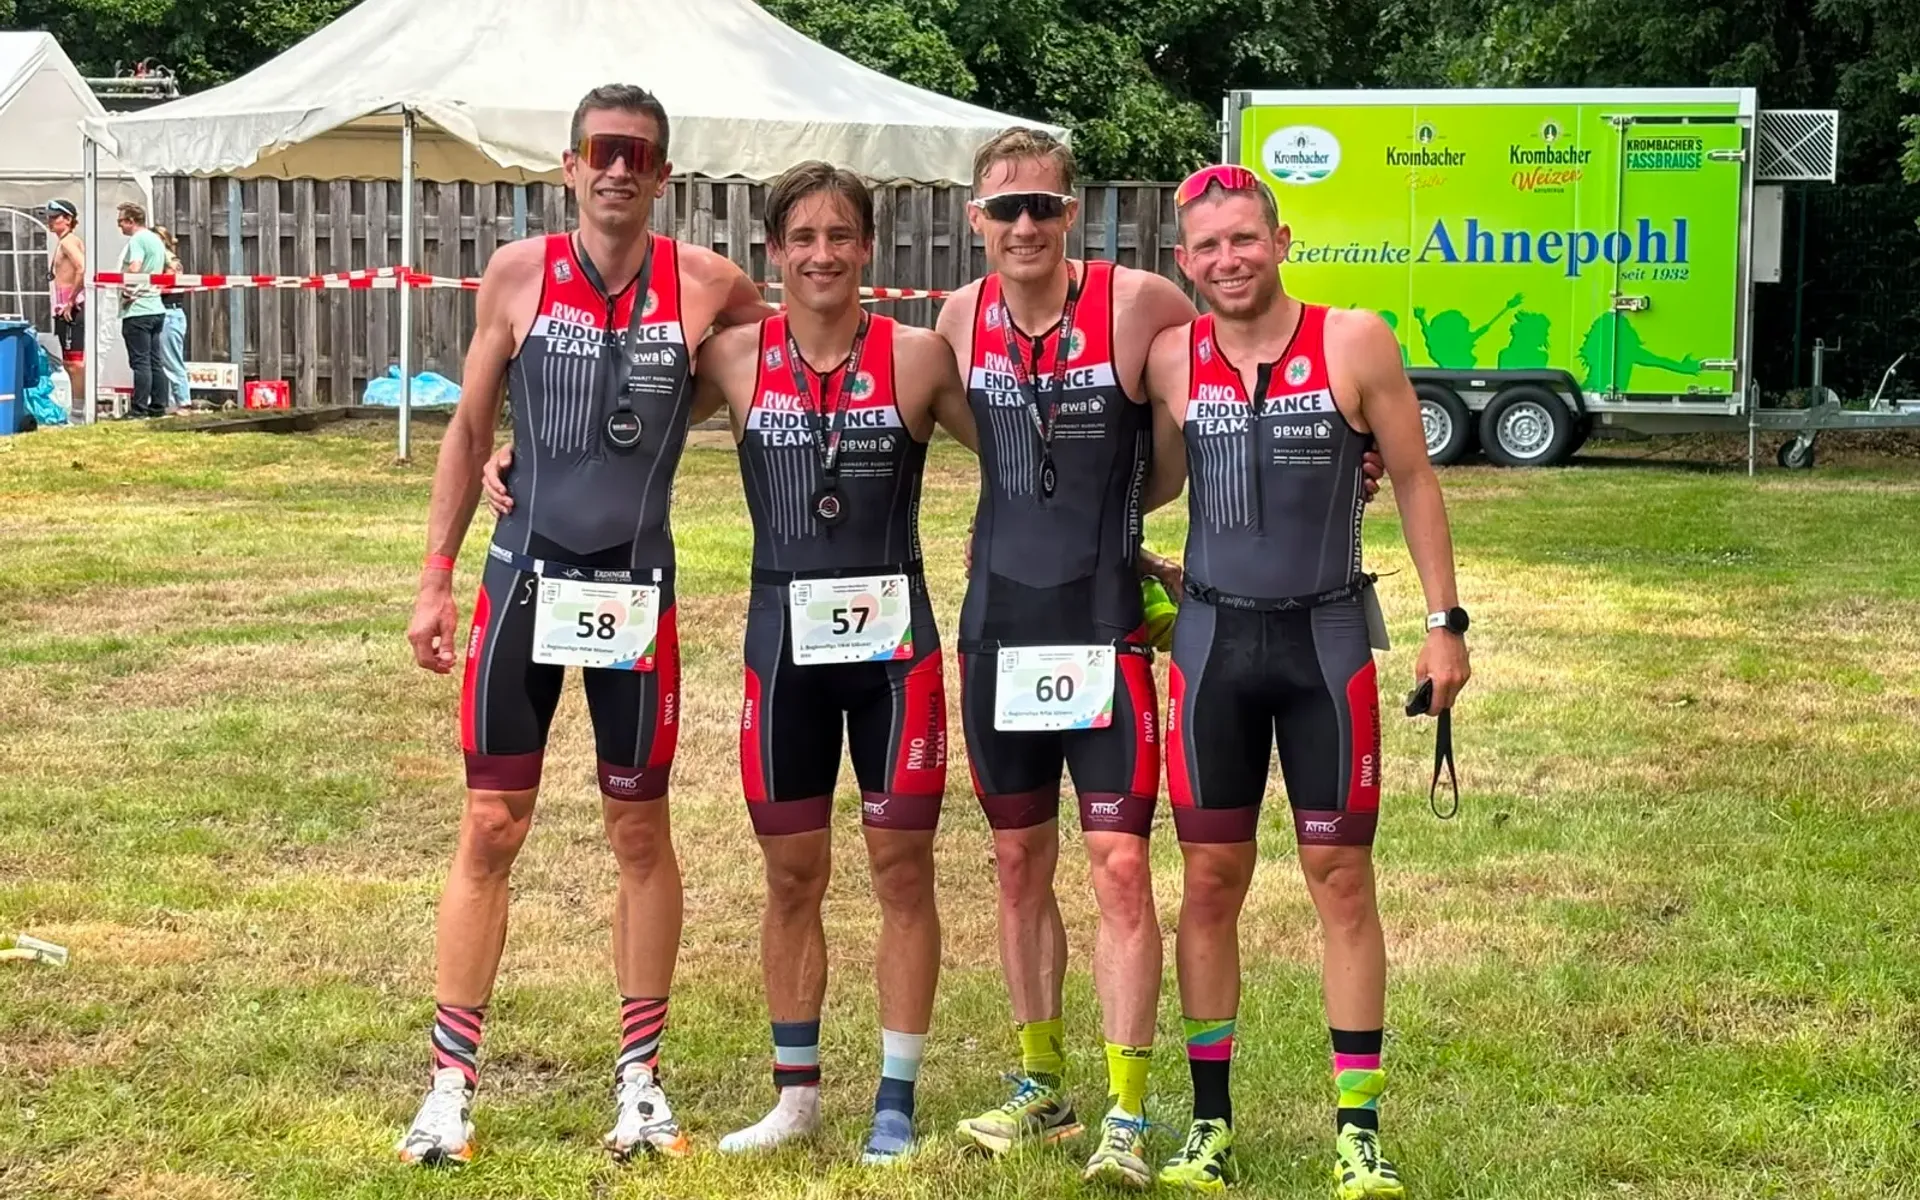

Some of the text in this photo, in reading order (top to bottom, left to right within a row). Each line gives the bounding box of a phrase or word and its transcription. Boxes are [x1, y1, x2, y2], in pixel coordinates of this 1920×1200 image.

[1386, 146, 1466, 166] Krombacher
[1509, 145, 1592, 164] Krombacher
[1627, 139, 1702, 151] KROMBACHER'S
[1274, 150, 1330, 165] Krombacher
[1627, 152, 1702, 169] FASSBRAUSE
[1286, 217, 1690, 279] Getränke Ahnepohl
[1621, 267, 1690, 282] seit 1932
[551, 301, 596, 328] RWO
[546, 337, 600, 359] TEAM
[1198, 383, 1237, 401] RWO
[760, 430, 815, 447] TEAM
[1197, 419, 1248, 437] TEAM
[1273, 425, 1312, 439] gewa
[840, 440, 877, 453] gewa
[577, 611, 616, 640] 58
[832, 606, 870, 635] 57
[468, 625, 481, 660] RWO
[1036, 675, 1074, 703] 60
[663, 692, 674, 727] RWO
[743, 698, 753, 730] RWO
[1143, 711, 1154, 743] RWO
[906, 737, 925, 770] RWO
[1360, 753, 1373, 788] RWO
